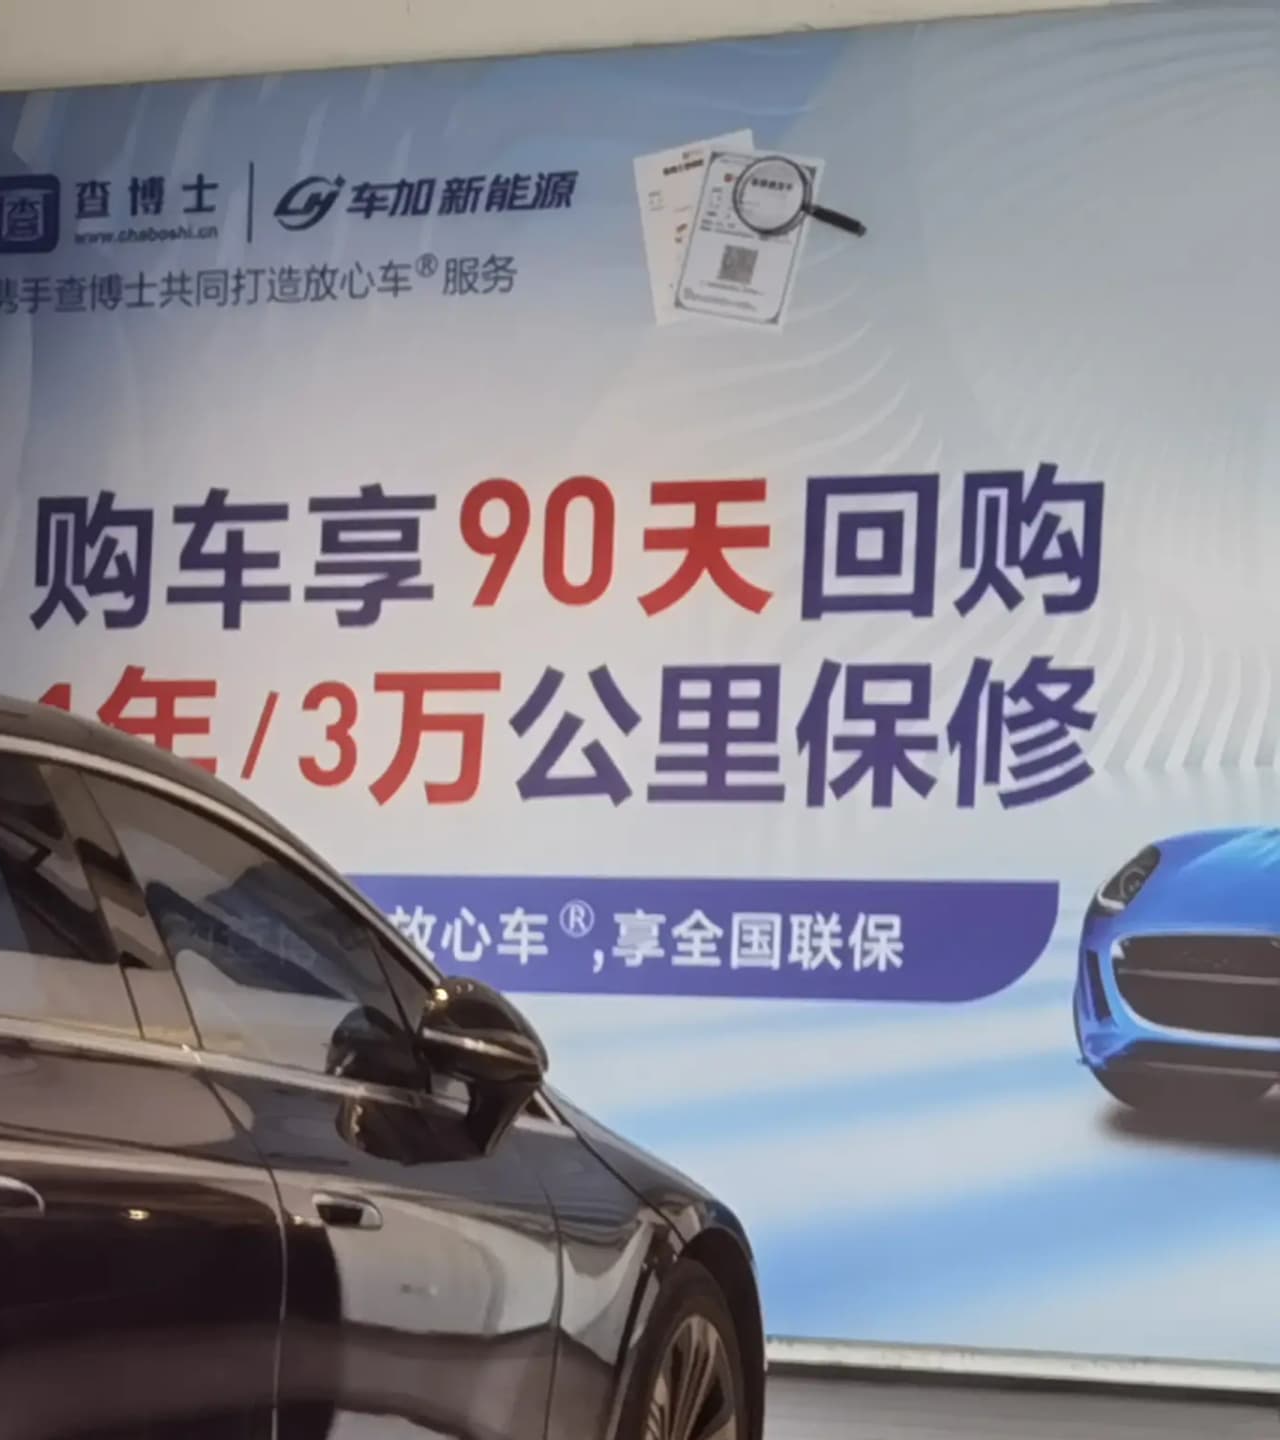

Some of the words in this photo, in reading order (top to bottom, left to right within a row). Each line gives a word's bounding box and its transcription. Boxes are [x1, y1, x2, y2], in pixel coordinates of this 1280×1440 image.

[75, 173, 219, 219] 查博士
[346, 170, 578, 218] 车加新能源
[30, 463, 1105, 629] 购车享90天回购
